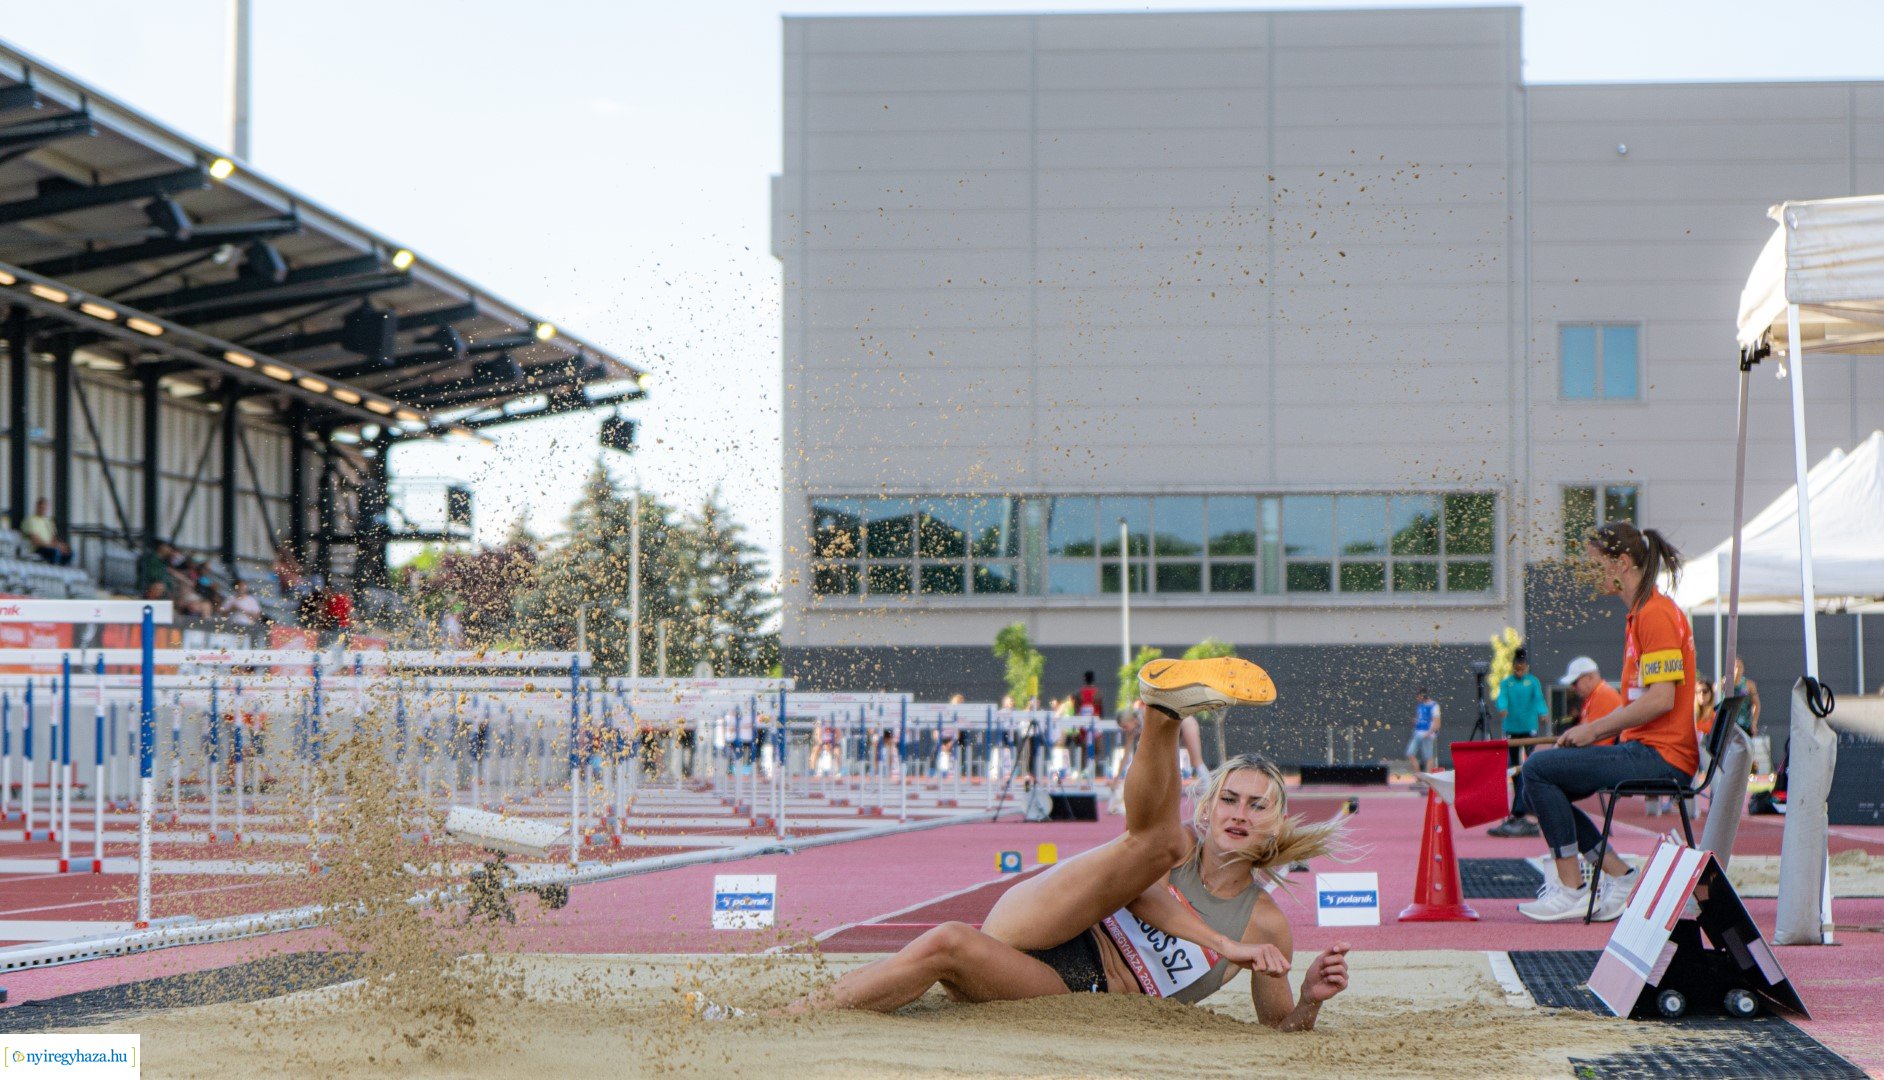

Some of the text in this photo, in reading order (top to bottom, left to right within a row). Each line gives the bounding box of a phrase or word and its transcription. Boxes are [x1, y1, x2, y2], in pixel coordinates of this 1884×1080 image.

[1645, 660, 1662, 675] CHIEF
[732, 897, 769, 907] poanik
[1336, 894, 1373, 905] polanik
[1161, 948, 1194, 985] SZ.
[1140, 973, 1157, 997] 2023
